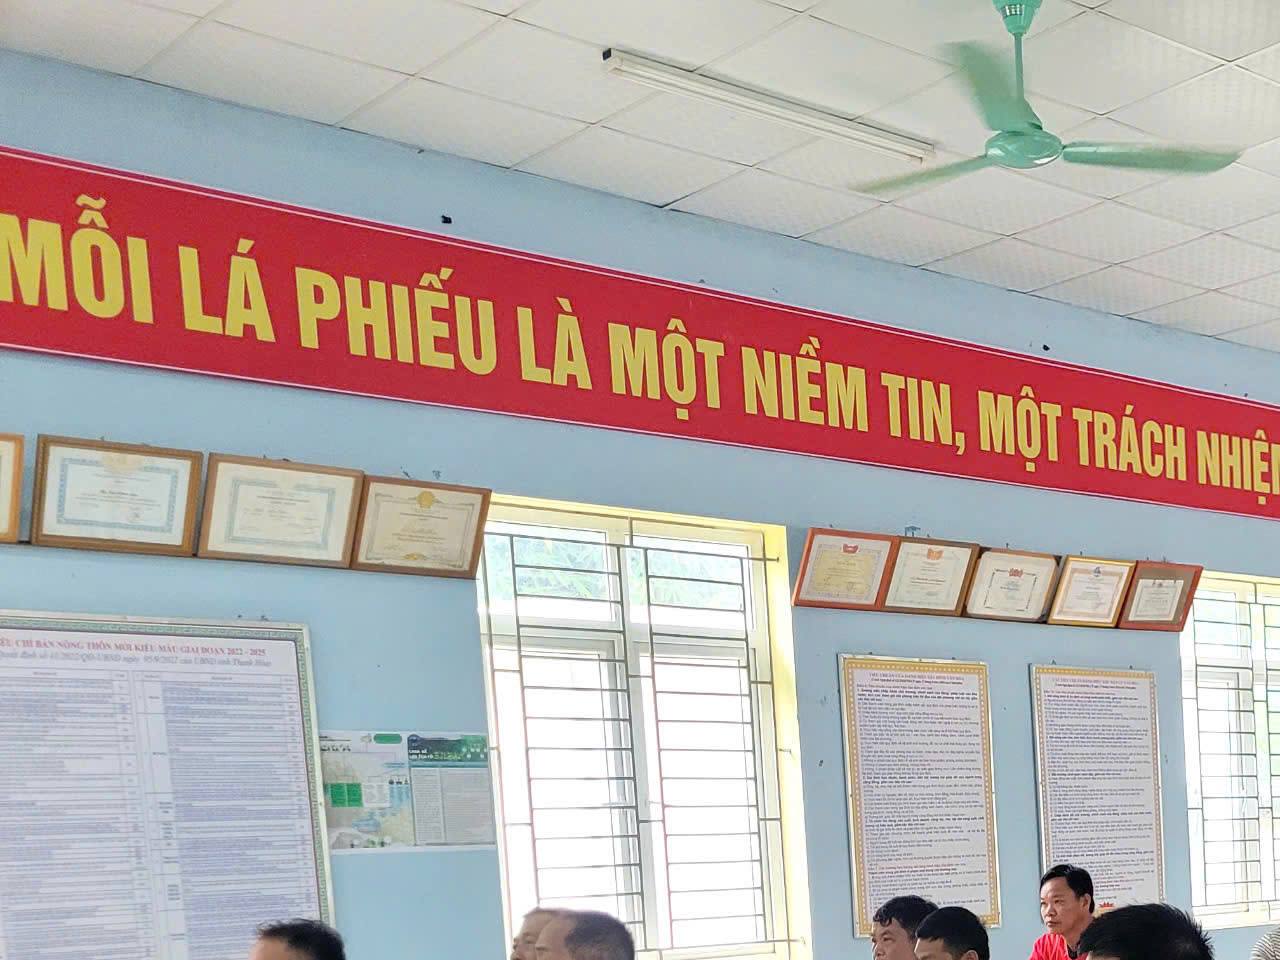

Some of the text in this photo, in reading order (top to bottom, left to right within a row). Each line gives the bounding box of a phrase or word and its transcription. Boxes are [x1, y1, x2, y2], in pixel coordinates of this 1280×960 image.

[0, 193, 155, 325] MỖI
[178, 237, 277, 343] LÁ
[295, 267, 498, 376] PHIẾU
[516, 296, 593, 390] LÀ
[607, 318, 725, 421] MỘT
[741, 336, 870, 433] NIỀM
[880, 372, 966, 456] TIN,
[977, 385, 1063, 473] MỘT
[1072, 404, 1188, 482] TRÁCH
